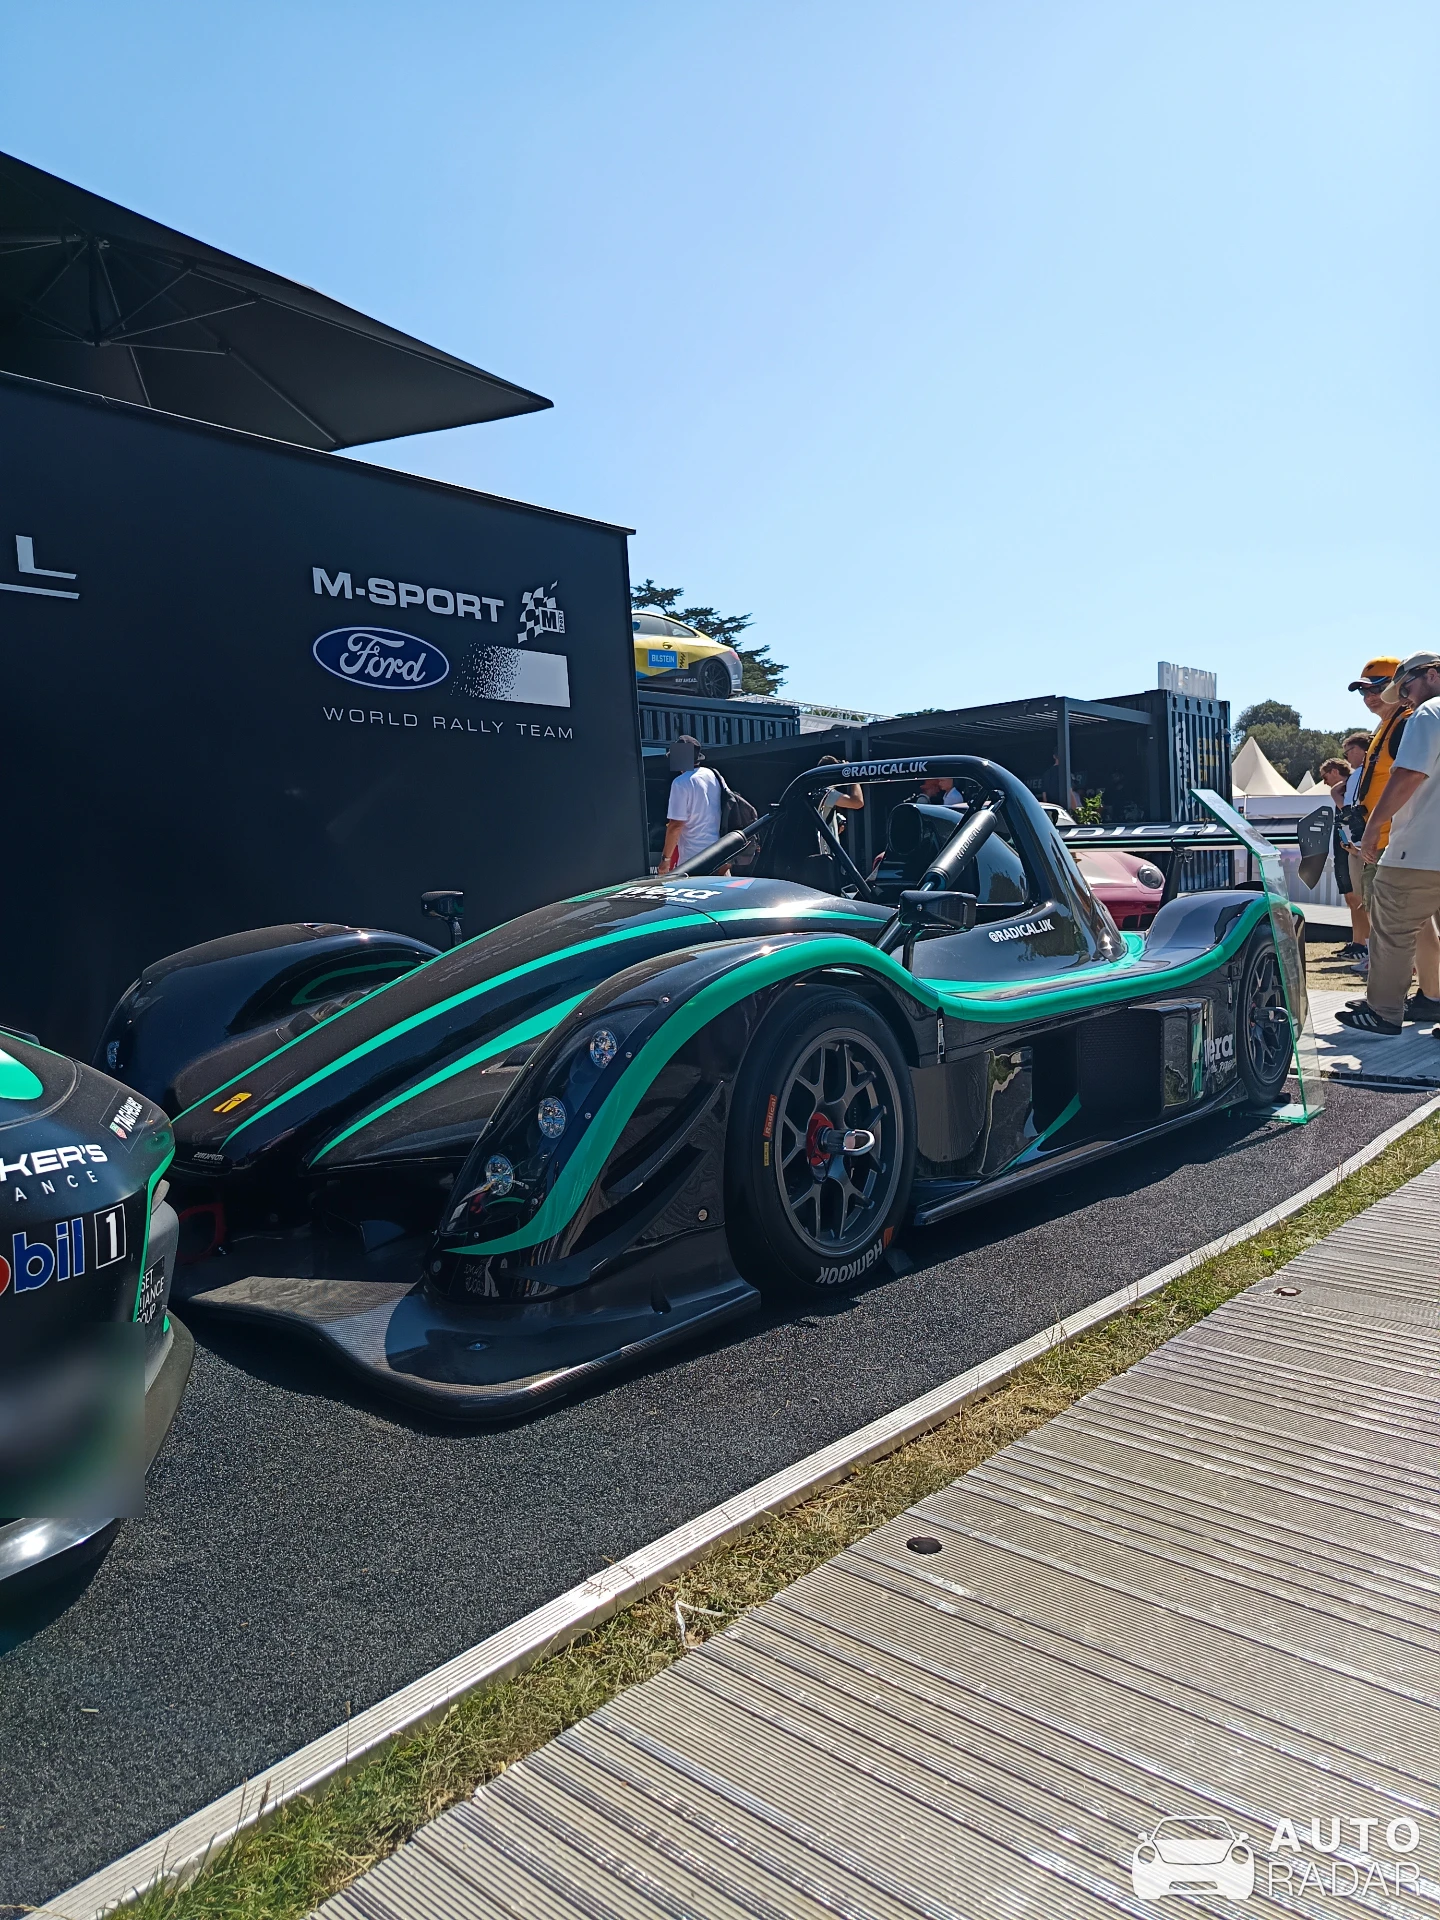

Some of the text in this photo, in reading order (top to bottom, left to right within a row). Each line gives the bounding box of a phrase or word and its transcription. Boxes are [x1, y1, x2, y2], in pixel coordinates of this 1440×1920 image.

[312, 567, 504, 623] M-SPORT
[340, 633, 426, 682] Ford
[651, 654, 675, 663] BILSTEIN
[323, 706, 573, 739] WORLD RALLY TEAM
[841, 760, 929, 777] @RADICAL.UK
[988, 918, 1055, 943] @RADICAL.UK
[0, 1144, 108, 1182] KER'S
[15, 1170, 98, 1202] ANCE
[0, 1211, 118, 1295] bil 1
